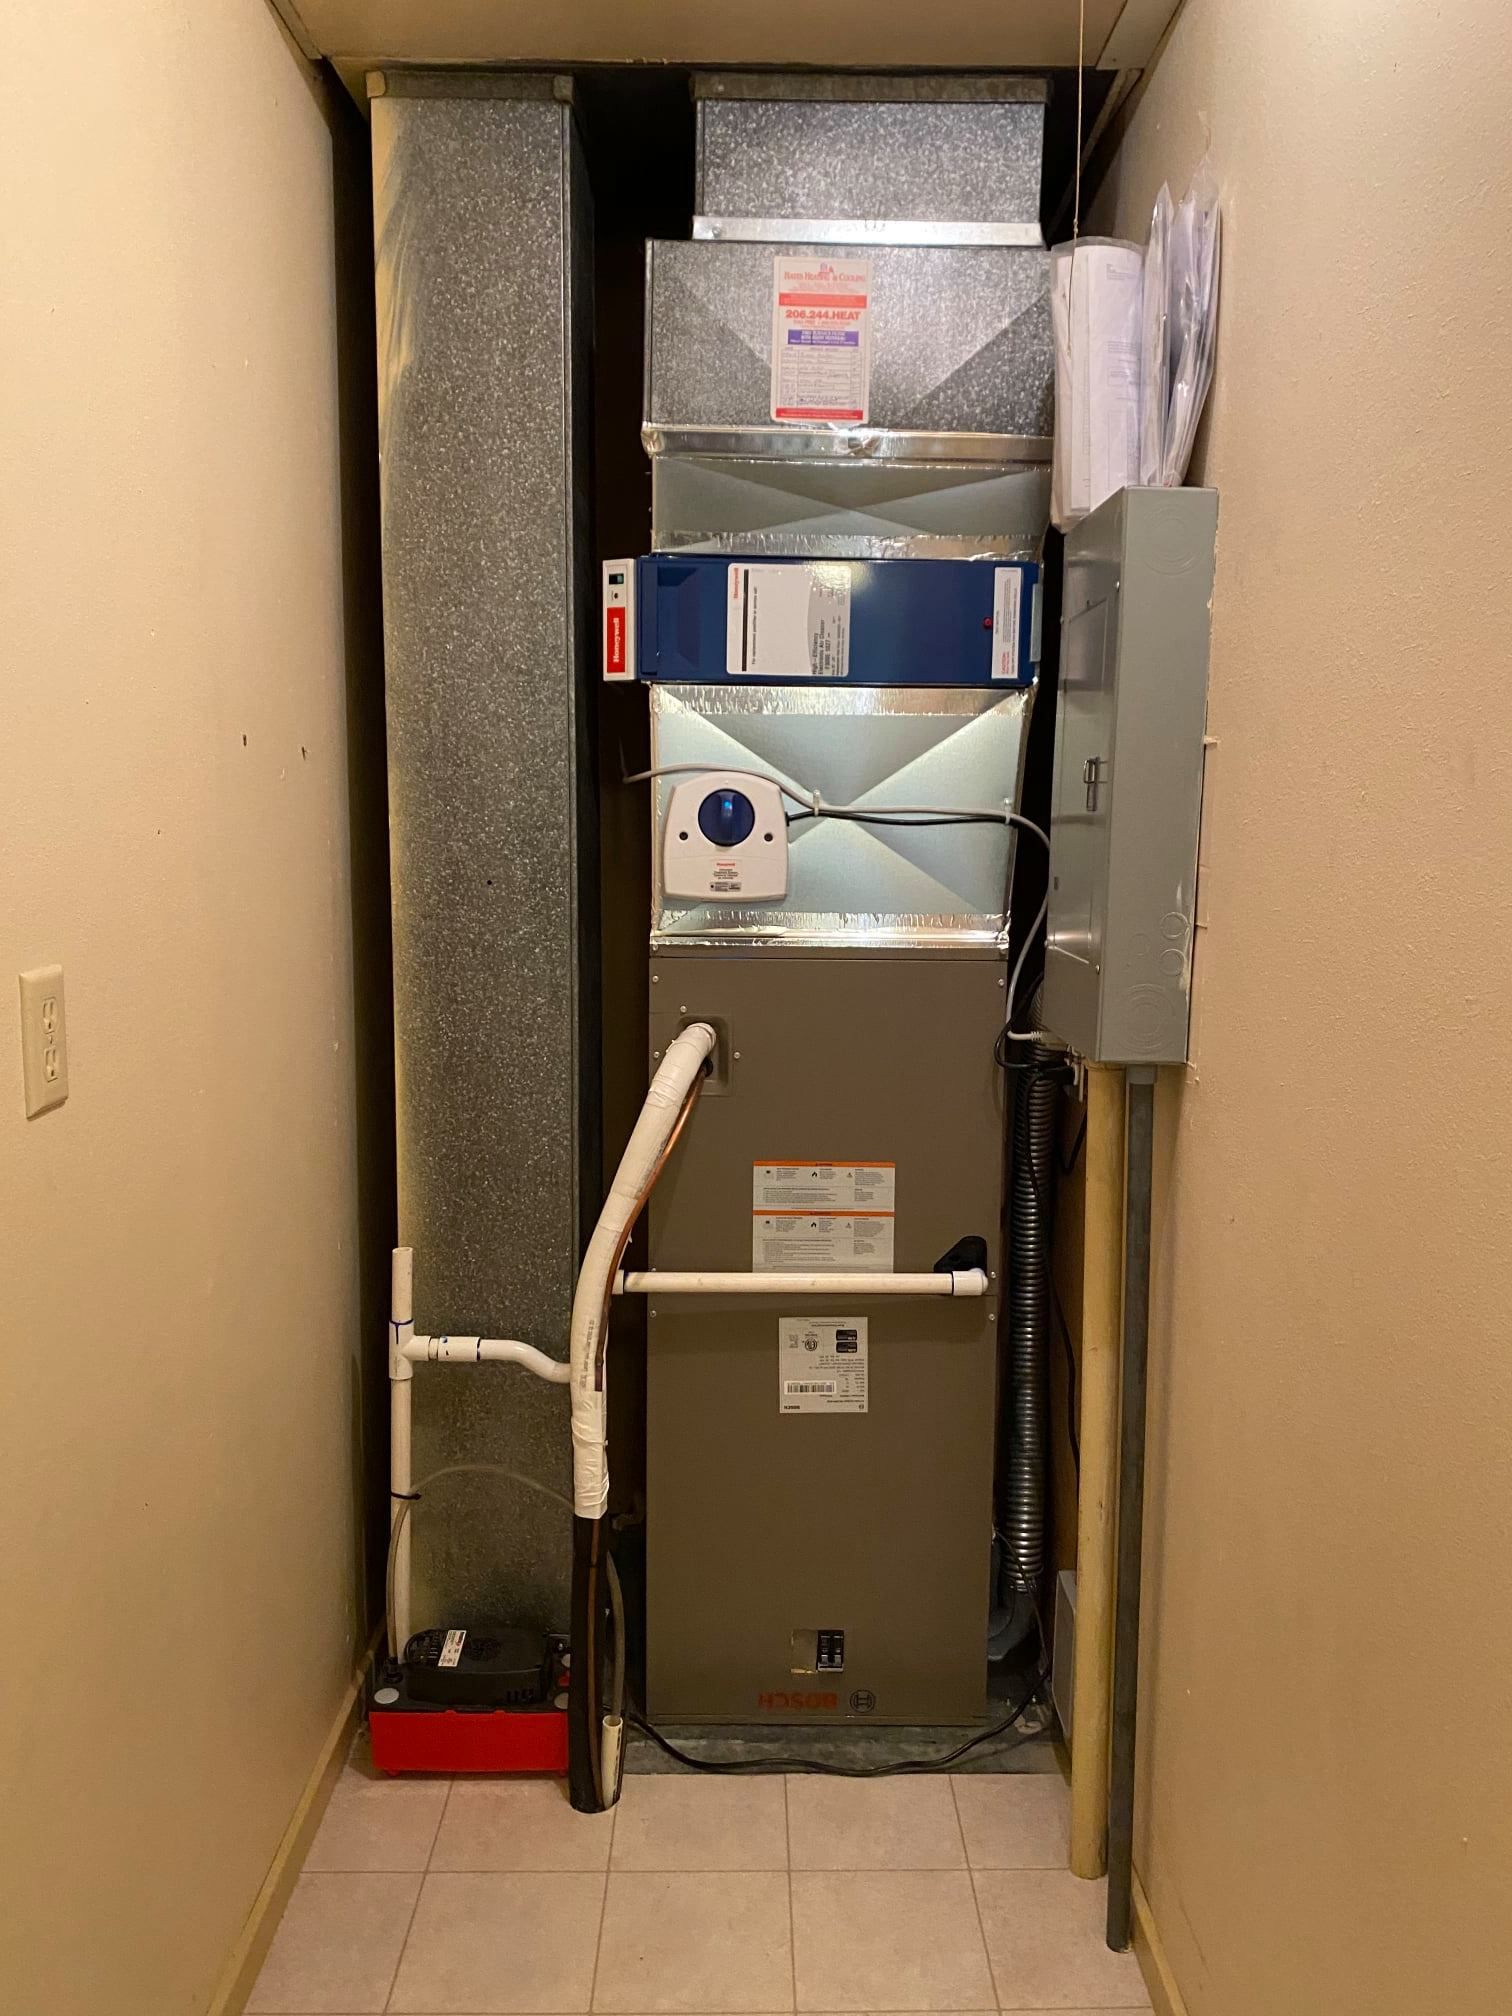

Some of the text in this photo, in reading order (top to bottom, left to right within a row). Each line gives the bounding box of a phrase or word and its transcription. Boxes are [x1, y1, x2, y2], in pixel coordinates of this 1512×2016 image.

[786, 310, 861, 321] 206.244.HEAT
[612, 617, 620, 663] Honeywell
[757, 1692, 838, 1710] BOSCH
